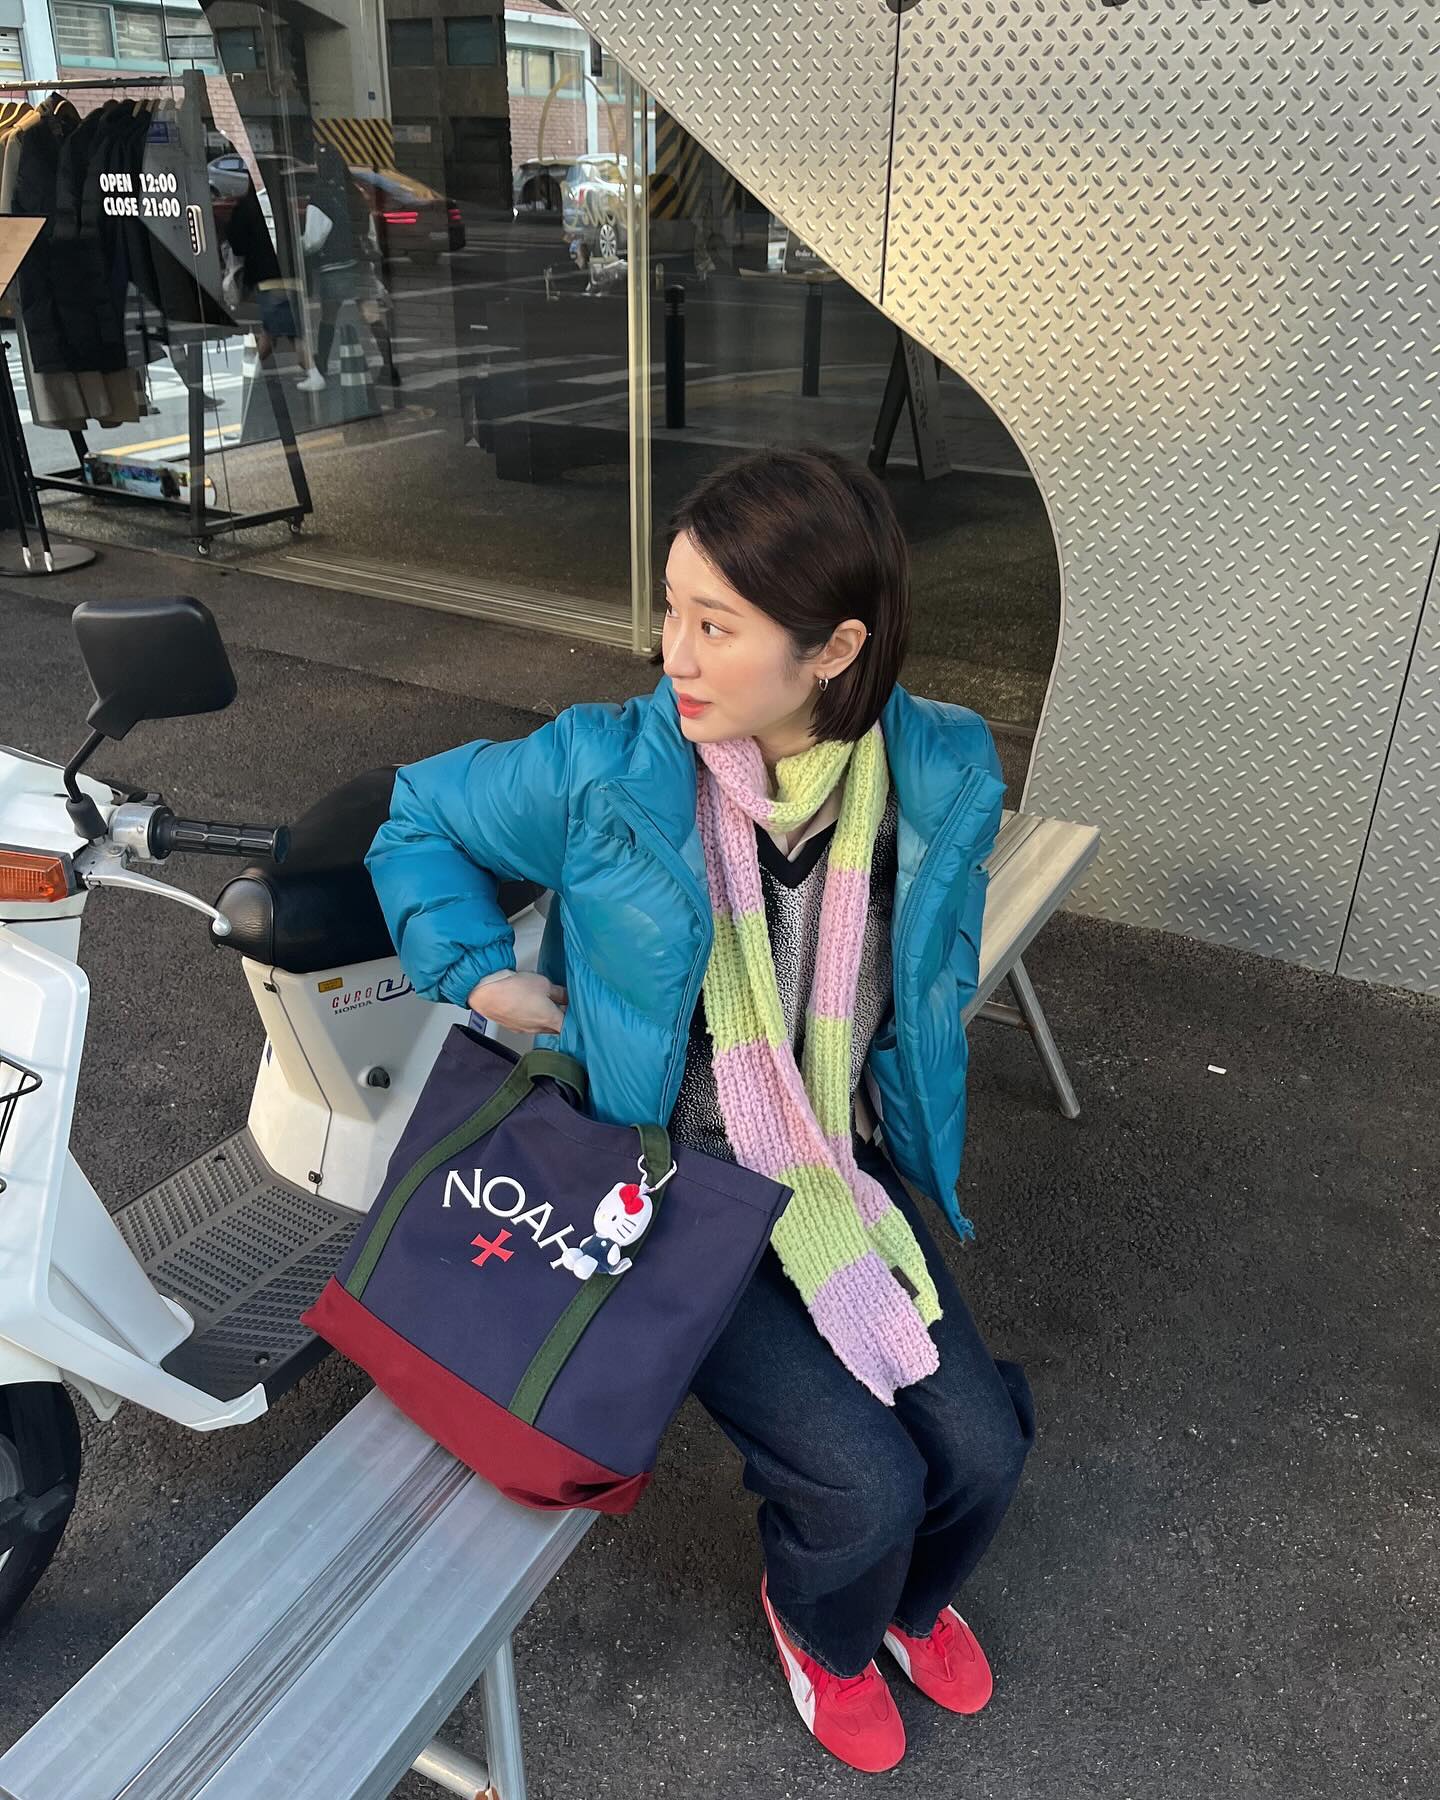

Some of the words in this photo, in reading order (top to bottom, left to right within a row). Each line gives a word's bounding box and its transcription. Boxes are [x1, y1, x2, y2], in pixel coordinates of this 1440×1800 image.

[100, 173, 133, 193] OPEN
[139, 173, 177, 193] 12:00
[103, 197, 139, 217] CLOSE
[142, 197, 181, 217] 21:00
[334, 1000, 373, 1015] HONDA
[442, 1168, 576, 1270] NOAH
